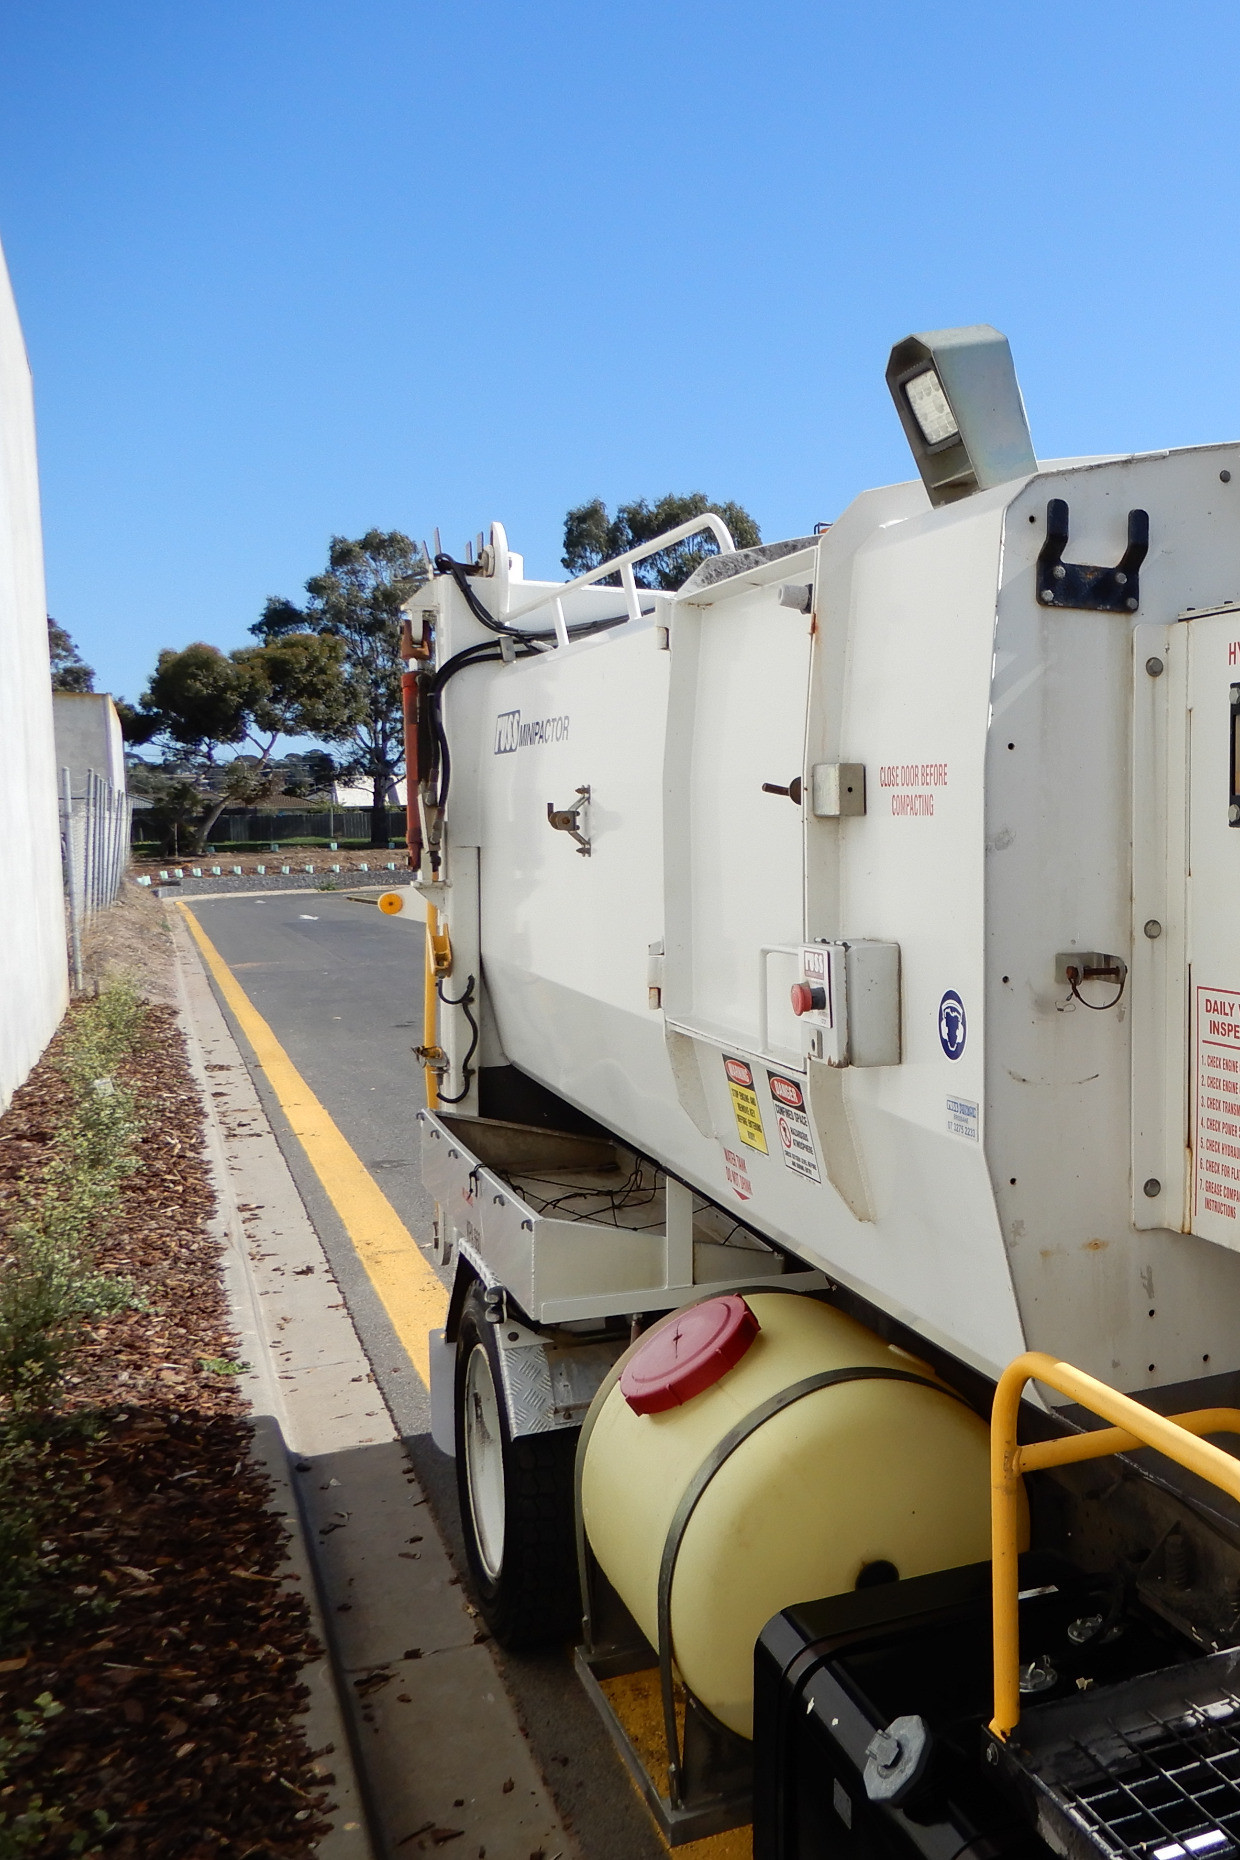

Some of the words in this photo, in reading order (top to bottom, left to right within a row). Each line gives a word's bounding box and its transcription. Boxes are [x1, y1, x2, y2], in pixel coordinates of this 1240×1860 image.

[880, 766, 899, 787] CLOSE
[901, 765, 919, 786] DOOR
[921, 763, 947, 786] BEFORE
[892, 794, 934, 816] COMPACTING
[1205, 999, 1235, 1017] DAILY
[1207, 1055, 1221, 1069] CHECK
[1223, 1058, 1238, 1073] ENGINE
[1207, 1076, 1221, 1090] CHECK
[1223, 1079, 1238, 1094] ENGINE
[1207, 1097, 1221, 1111] CHECK
[1207, 1117, 1221, 1132] CHECK
[1222, 1121, 1237, 1138] POWER
[1206, 1138, 1220, 1153] CHECK
[1206, 1159, 1220, 1174] CHECK
[1221, 1164, 1230, 1178] FOR
[1205, 1180, 1222, 1197] GREASE
[1205, 1197, 1236, 1219] INSTRUCTIONS
